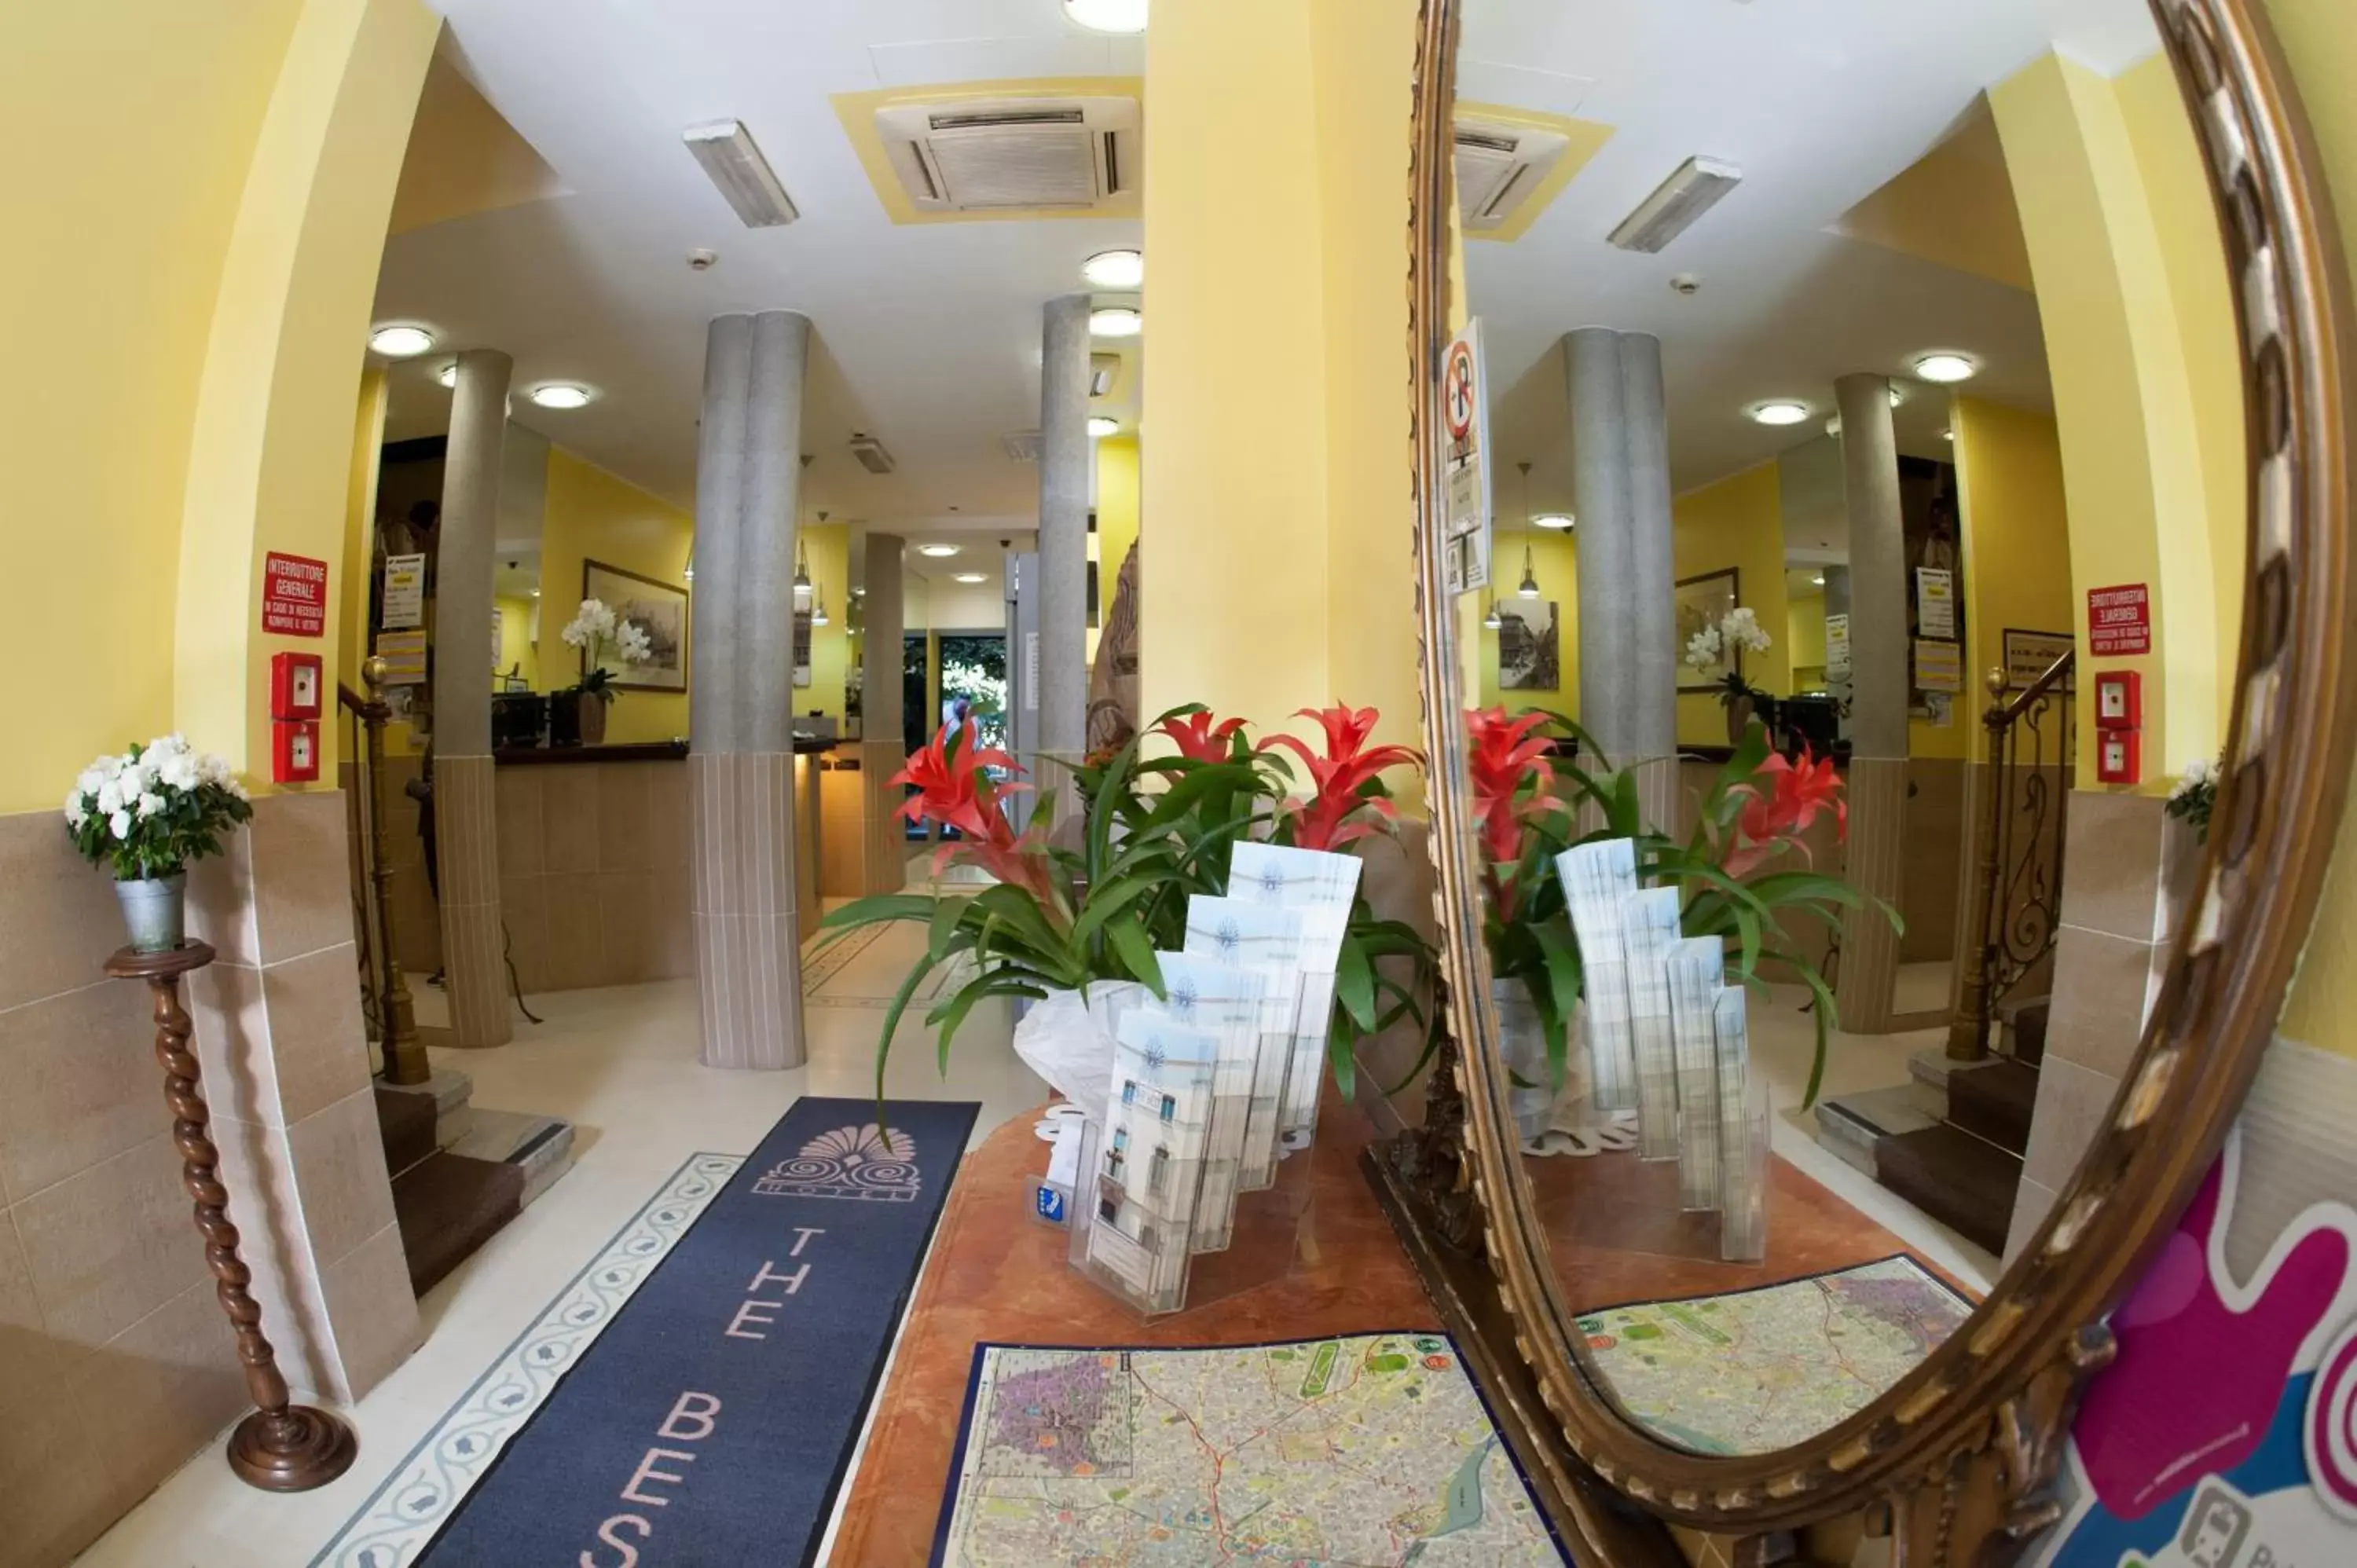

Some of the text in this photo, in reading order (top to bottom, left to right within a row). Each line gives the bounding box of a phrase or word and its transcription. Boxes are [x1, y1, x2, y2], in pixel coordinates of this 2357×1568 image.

[268, 559, 324, 582] INTERRUTTORE
[276, 579, 315, 599] GENERALE
[724, 1227, 826, 1339] THE
